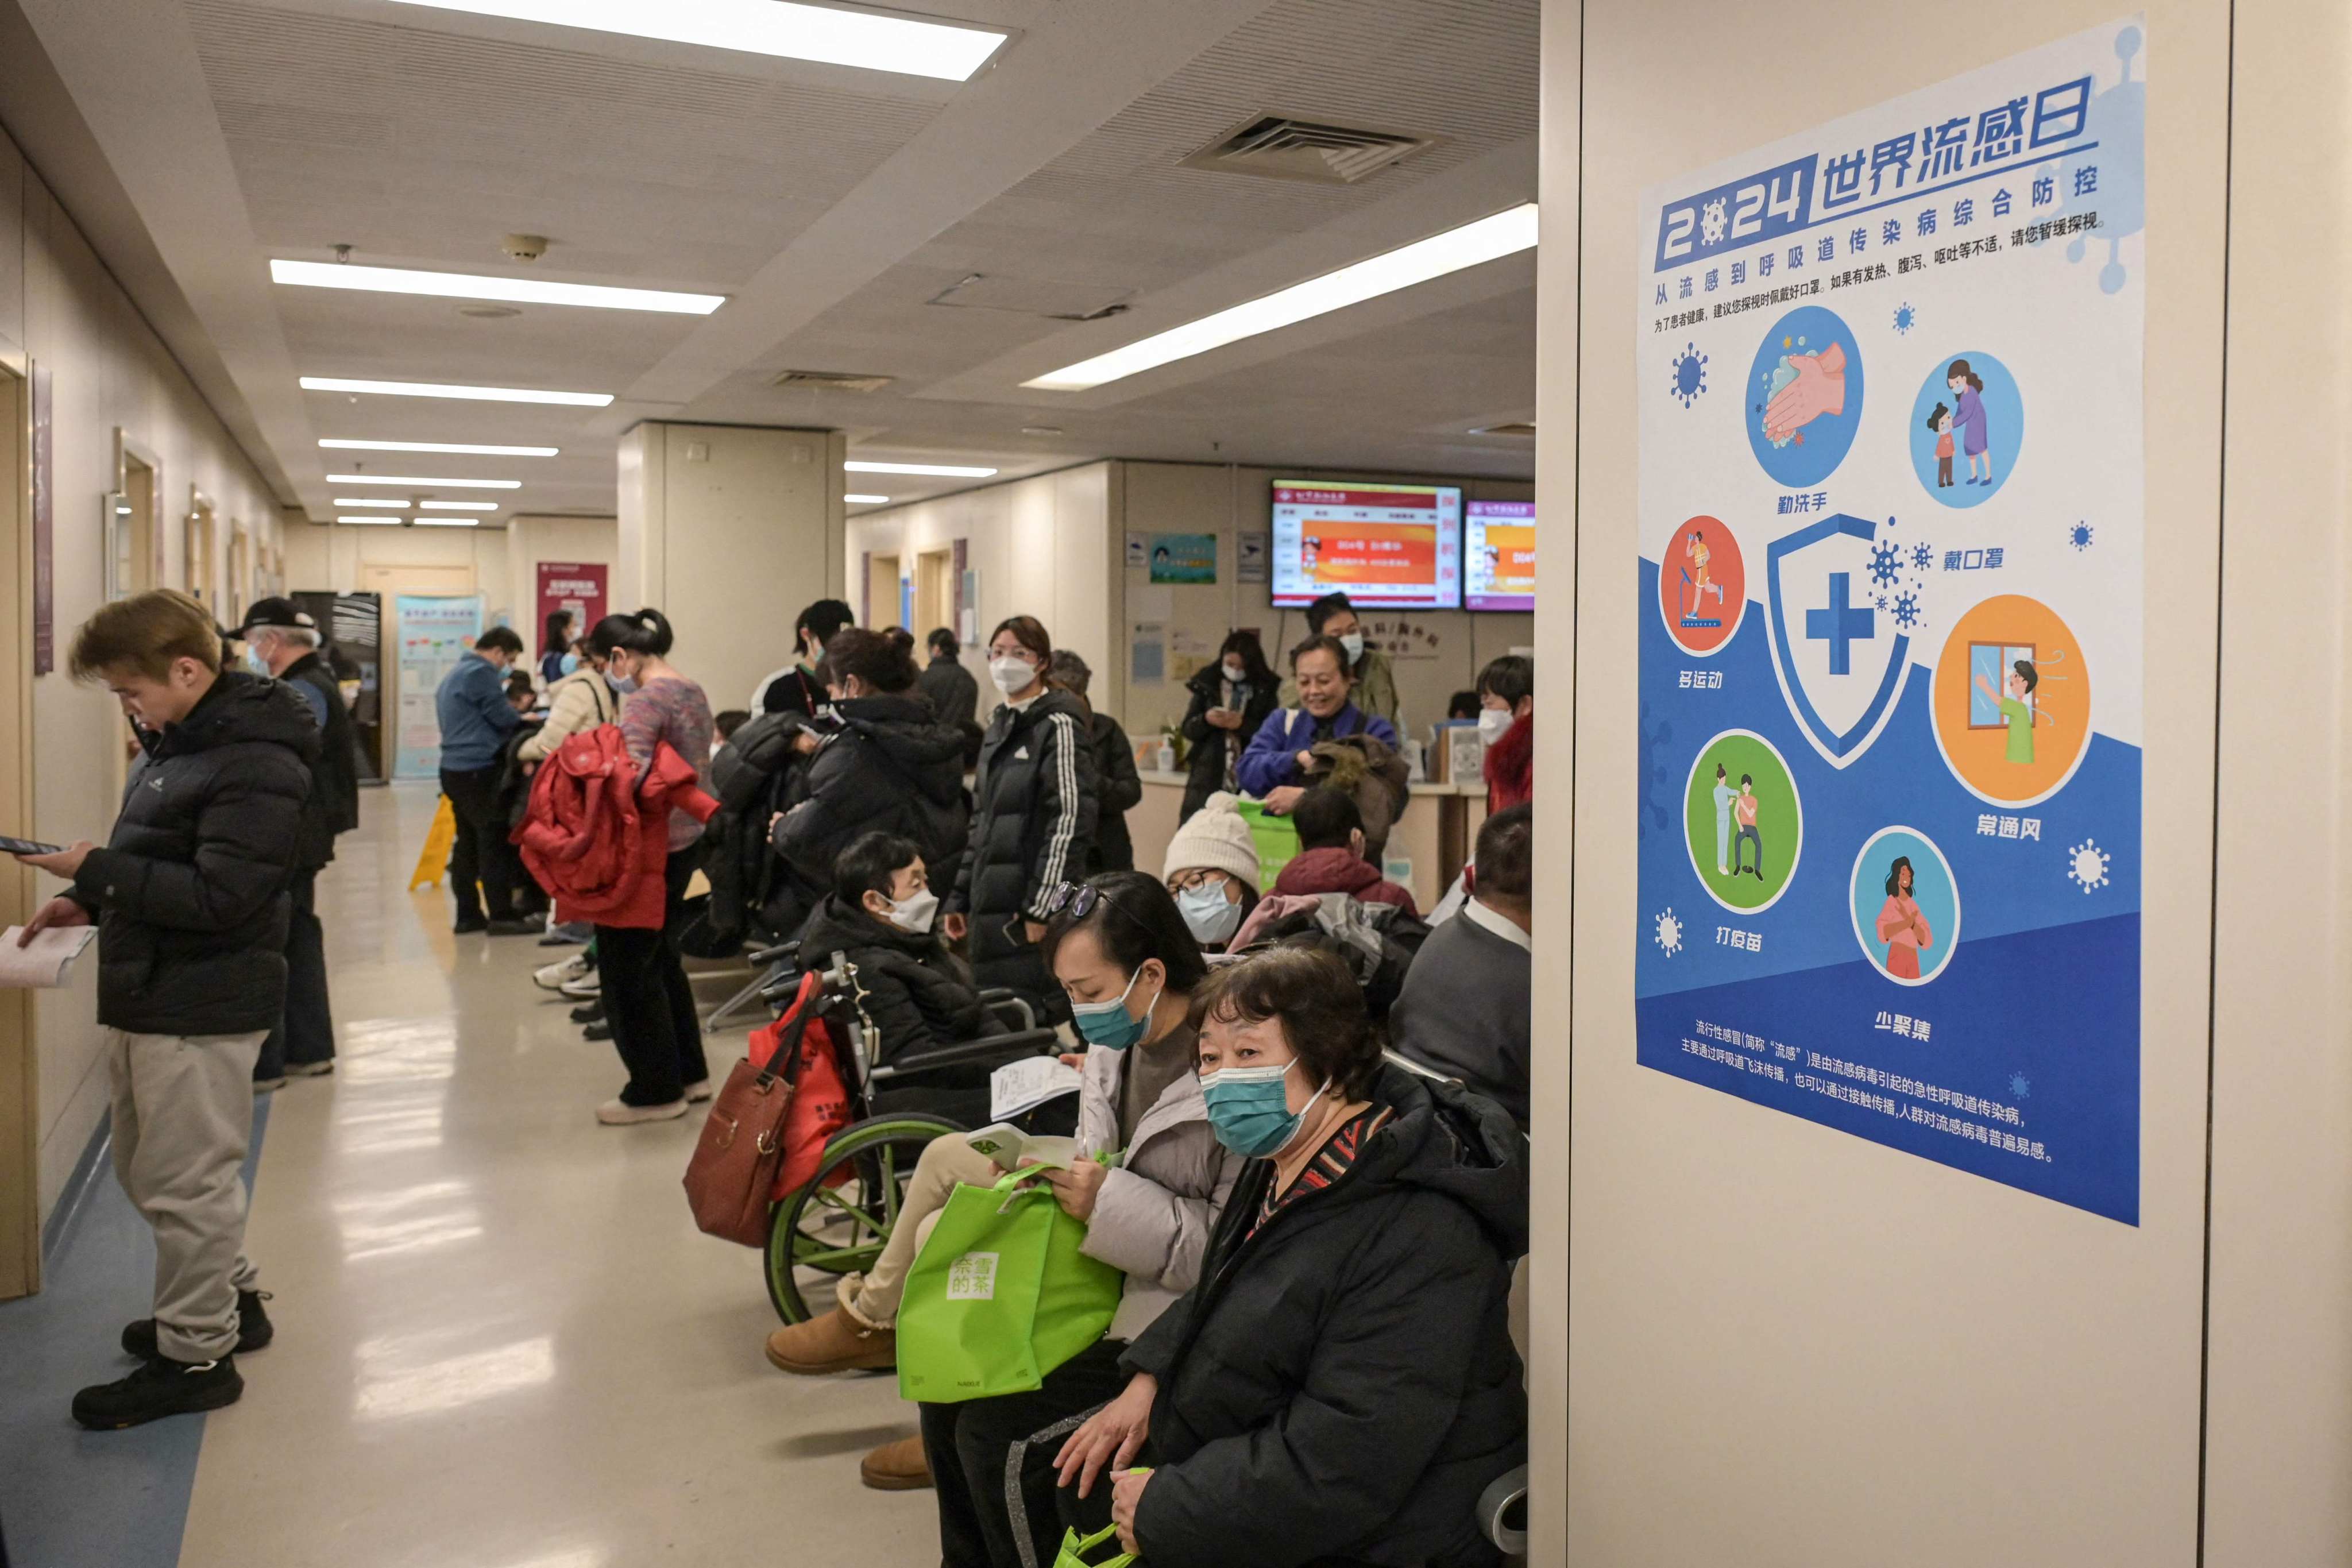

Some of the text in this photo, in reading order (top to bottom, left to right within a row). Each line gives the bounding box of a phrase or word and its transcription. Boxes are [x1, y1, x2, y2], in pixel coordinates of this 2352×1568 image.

[1655, 165, 2098, 306] 从流感到呼吸道传染病综合防控
[1778, 492, 1827, 514] 勤洗手
[1944, 548, 2003, 571] 戴口罩
[1678, 671, 1722, 689] 多运动
[1976, 814, 2041, 841] 常通风
[1716, 926, 1762, 952] 打疫苗
[1875, 1011, 1931, 1041] 少聚集
[952, 1276, 990, 1293] 的茶
